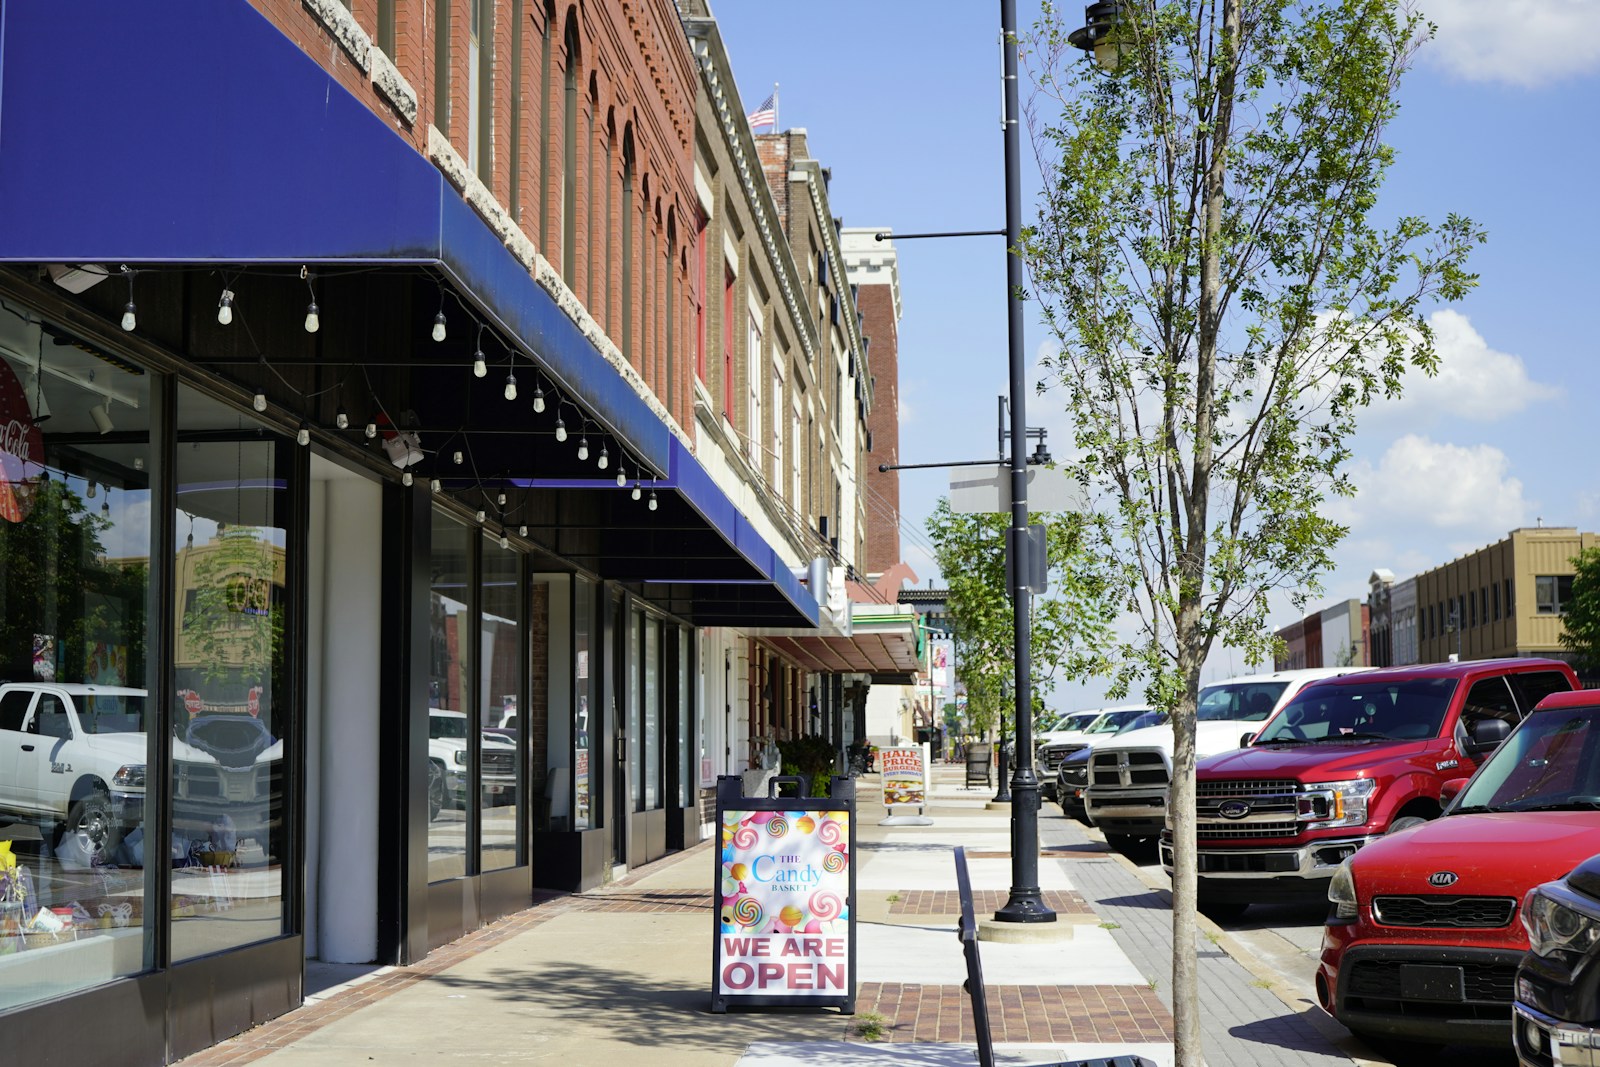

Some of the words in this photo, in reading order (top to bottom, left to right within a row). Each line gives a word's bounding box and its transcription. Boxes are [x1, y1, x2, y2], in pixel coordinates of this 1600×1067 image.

[883, 757, 921, 767] PRICE
[883, 765, 922, 773] BURGERS
[780, 855, 801, 864] THE
[751, 854, 823, 887] Candy
[1431, 873, 1453, 884] KIA
[771, 884, 808, 892] BASKET
[723, 937, 771, 957] WE
[780, 938, 845, 957] ARE
[722, 961, 845, 990] OPEN
